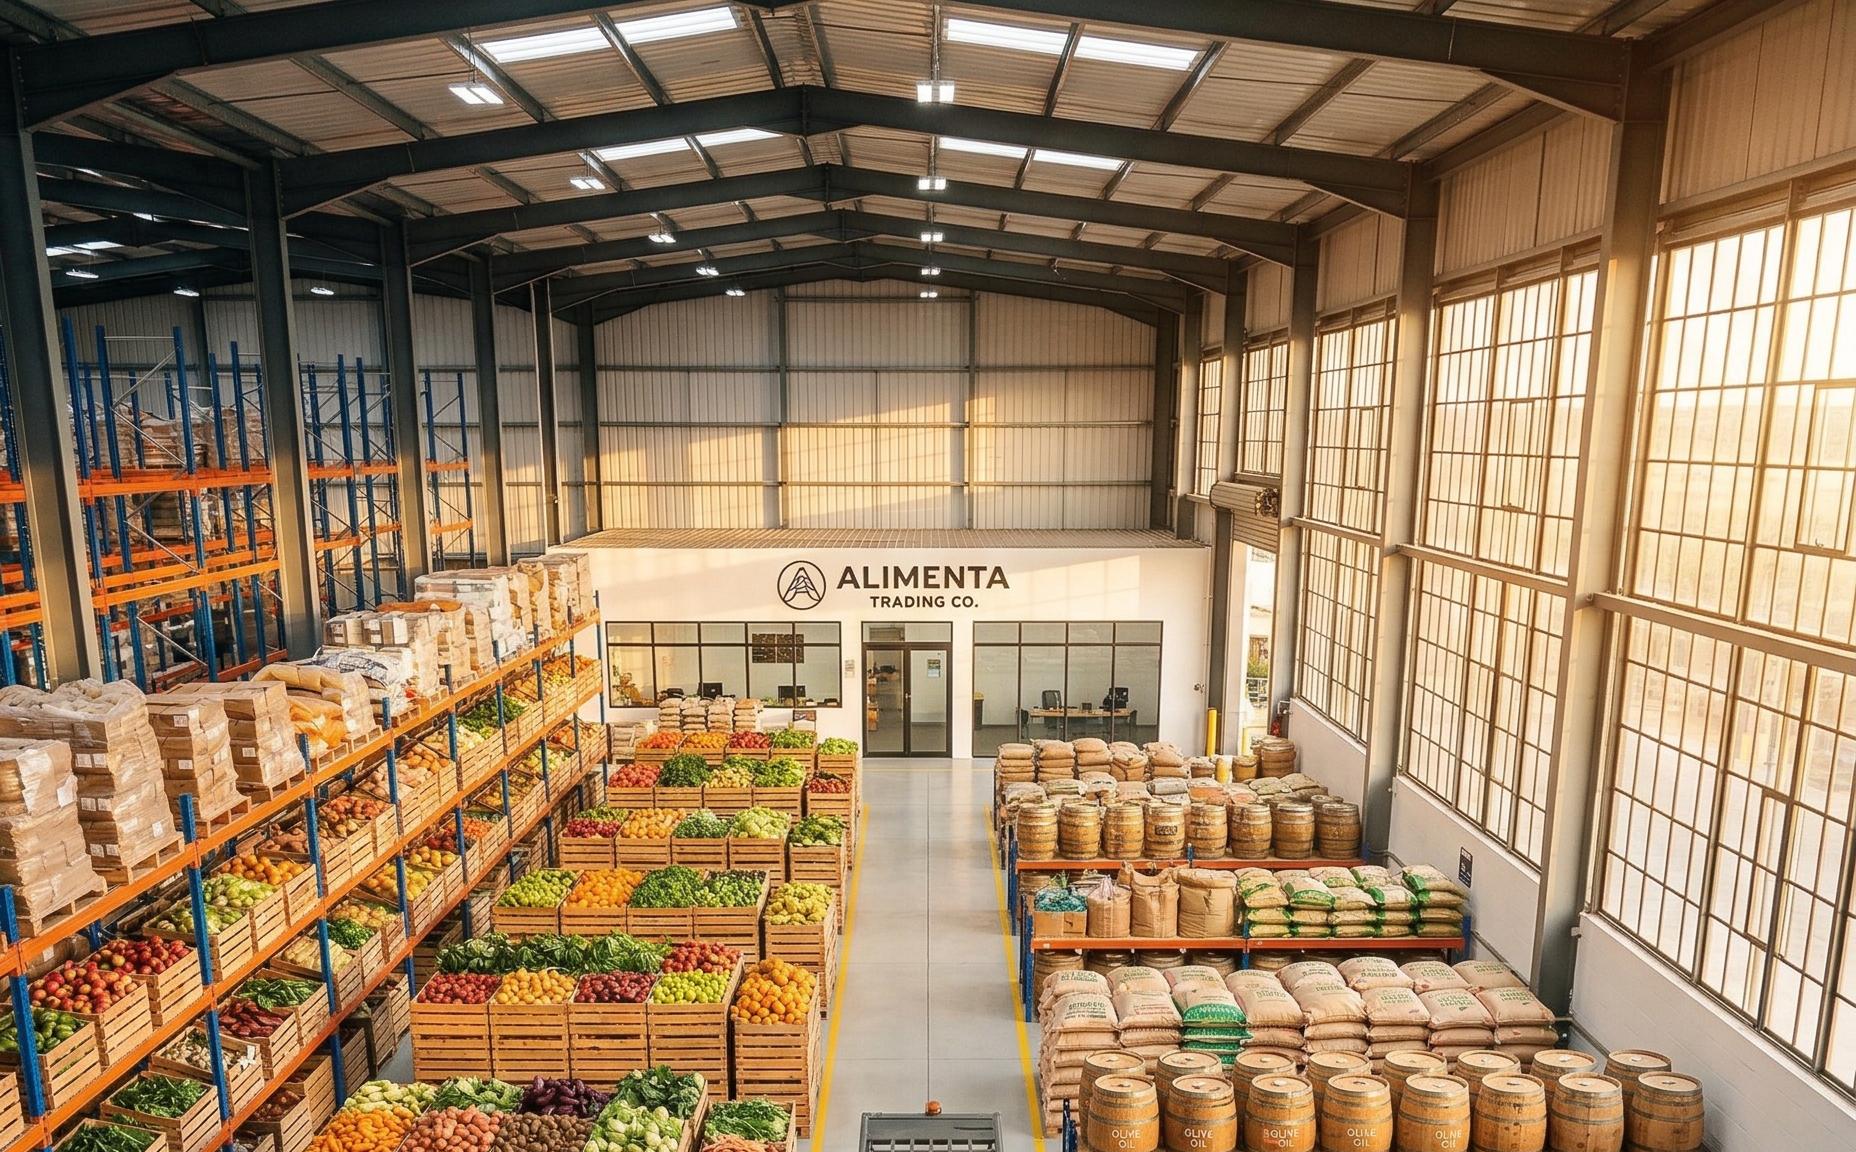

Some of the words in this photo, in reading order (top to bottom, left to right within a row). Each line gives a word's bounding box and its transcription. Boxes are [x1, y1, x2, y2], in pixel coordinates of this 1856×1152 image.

[836, 565, 1010, 590] ALIMENTA
[870, 596, 946, 608] TRADING
[951, 595, 979, 608] CO.
[1118, 1139, 1136, 1149] OIL
[1190, 1138, 1208, 1149] OIL
[1277, 1138, 1295, 1148] OIL
